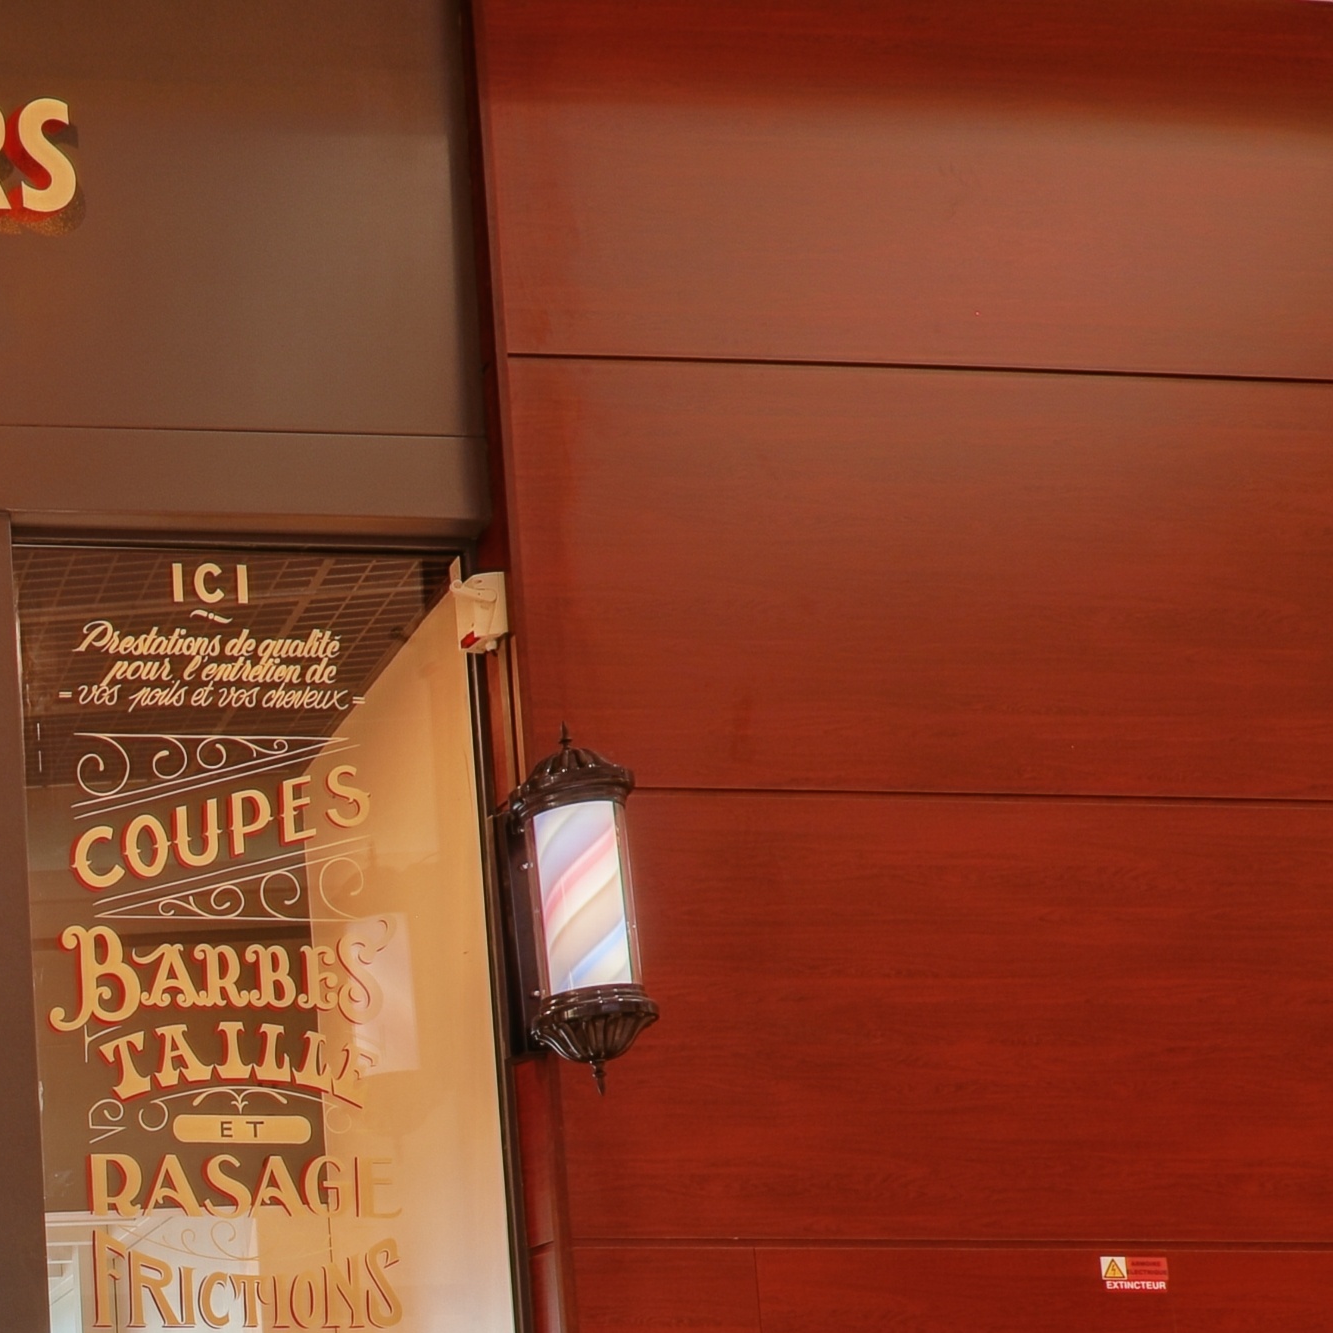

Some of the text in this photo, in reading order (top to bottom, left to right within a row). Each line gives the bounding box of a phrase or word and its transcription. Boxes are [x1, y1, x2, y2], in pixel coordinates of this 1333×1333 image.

[172, 562, 249, 604] ICI
[72, 620, 341, 664] Prestations de qualité
[99, 654, 337, 688] pour l'entretien de
[77, 682, 350, 713] vos poils et vos cheveux
[70, 764, 371, 892] COUPES
[48, 913, 397, 1031] BARBES
[99, 1021, 379, 1110] TAILLE
[219, 1120, 264, 1139] ET
[86, 1153, 403, 1220] RASAGE
[92, 1229, 402, 1330] FRICTIONS
[1105, 1280, 1167, 1290] EXTINCTEUR
